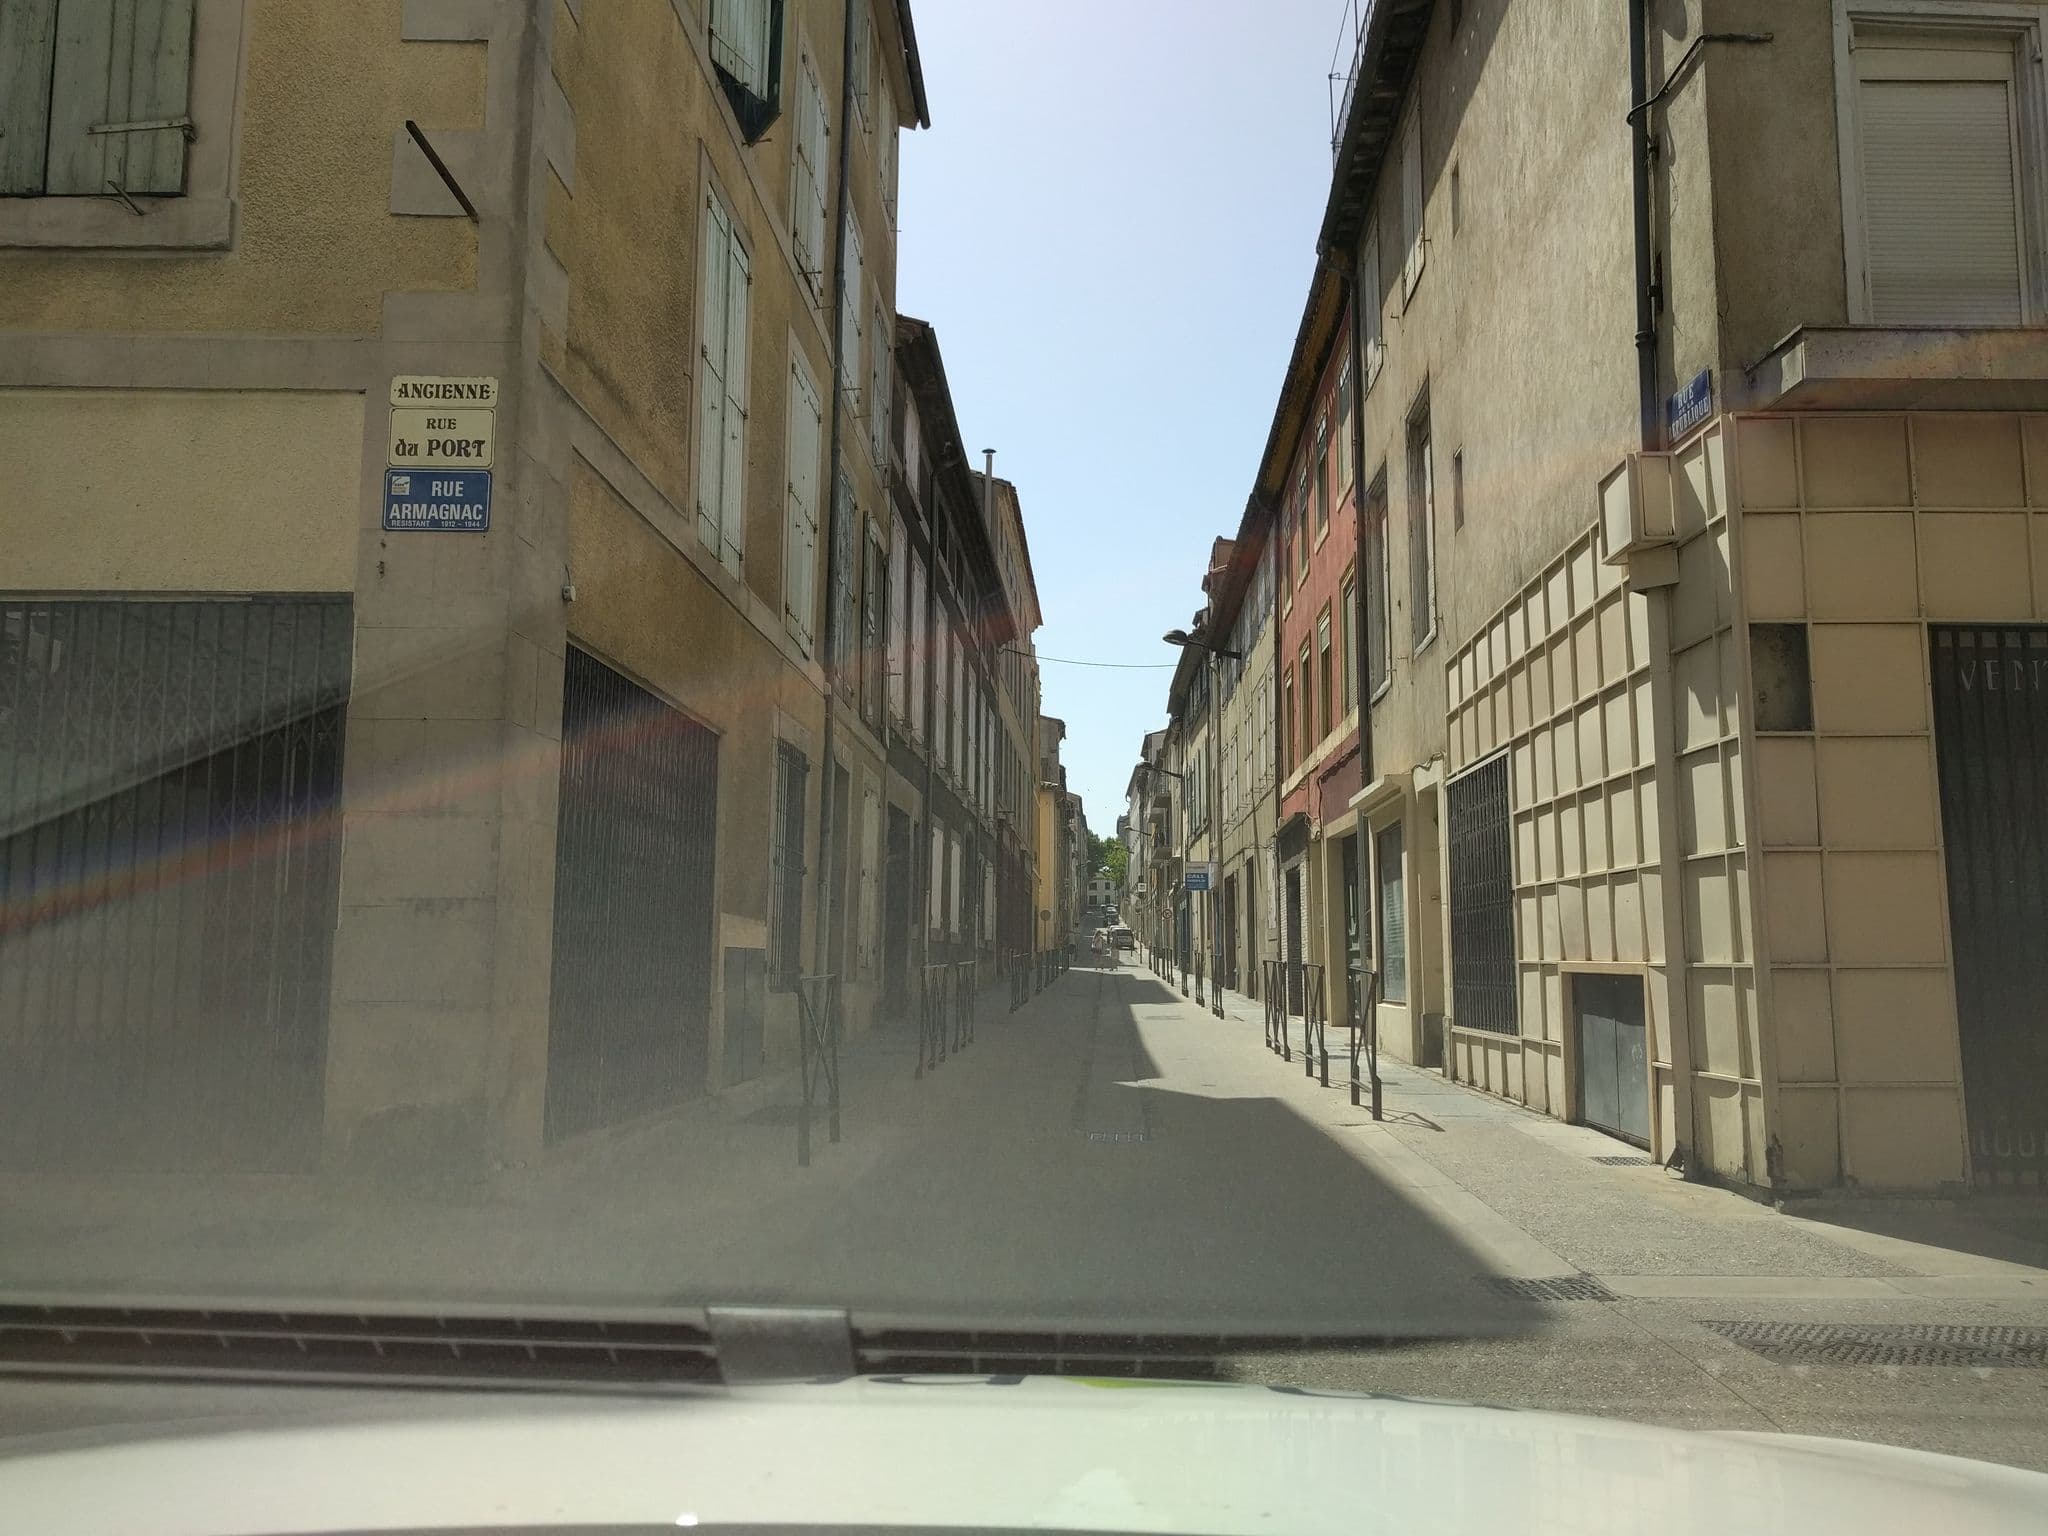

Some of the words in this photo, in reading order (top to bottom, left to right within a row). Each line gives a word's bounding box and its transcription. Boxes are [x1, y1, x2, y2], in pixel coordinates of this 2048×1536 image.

[1678, 384, 1694, 409] RUE
[427, 418, 457, 430] RUE
[395, 439, 418, 456] du
[427, 439, 486, 458] PORT
[432, 481, 464, 497] RUE
[389, 503, 483, 520] ARMAGNAC
